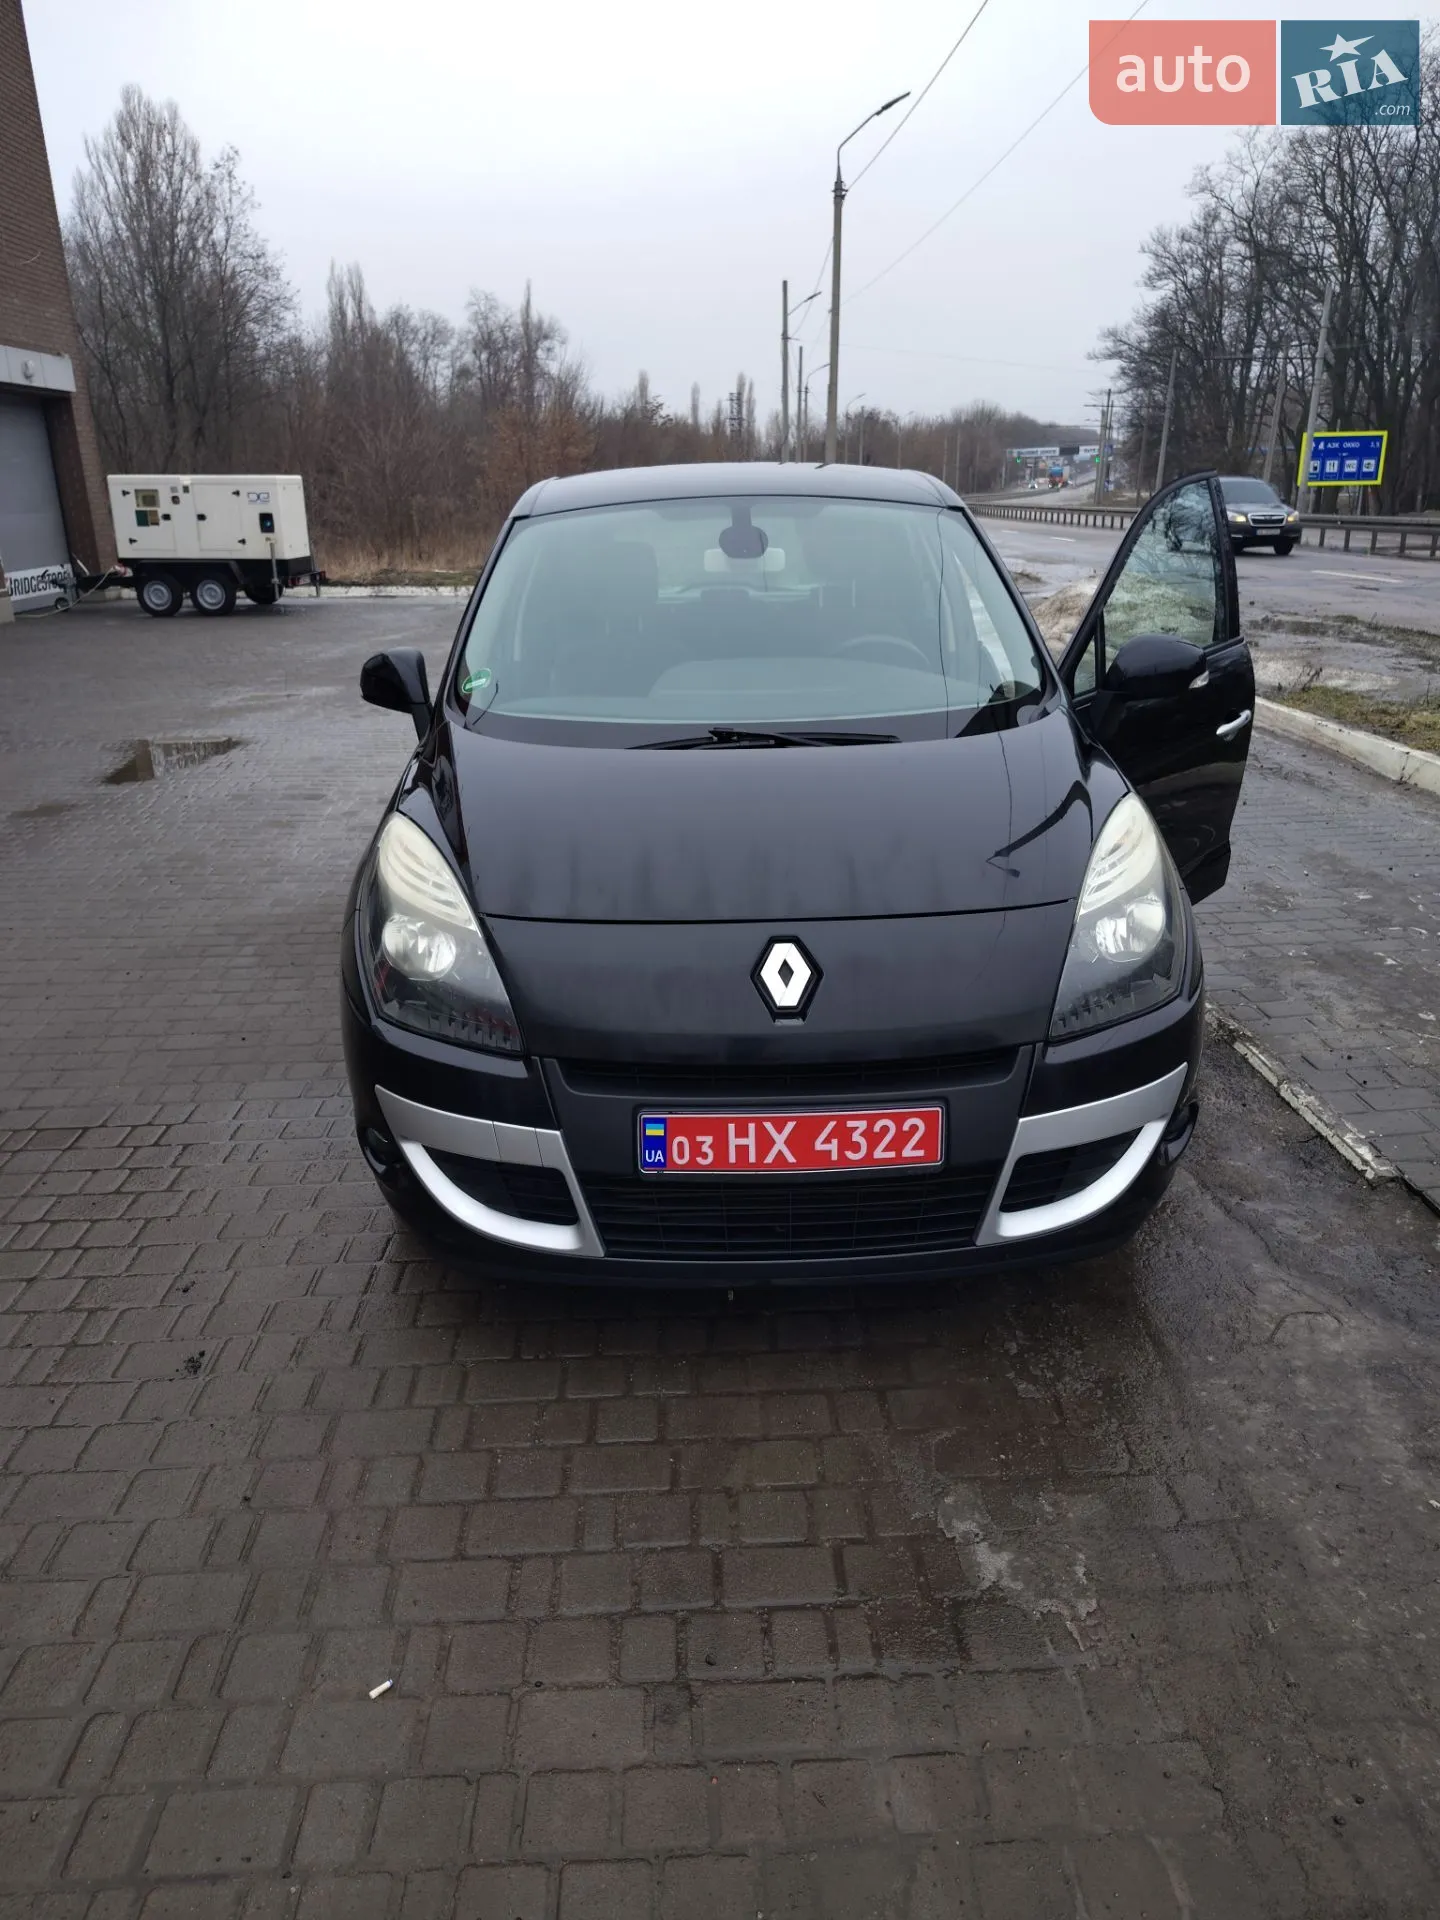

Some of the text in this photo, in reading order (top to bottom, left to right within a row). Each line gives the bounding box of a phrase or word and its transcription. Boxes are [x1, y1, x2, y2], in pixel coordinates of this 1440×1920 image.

[645, 1149, 664, 1163] UA
[671, 1117, 925, 1165] 03 HX 4322
